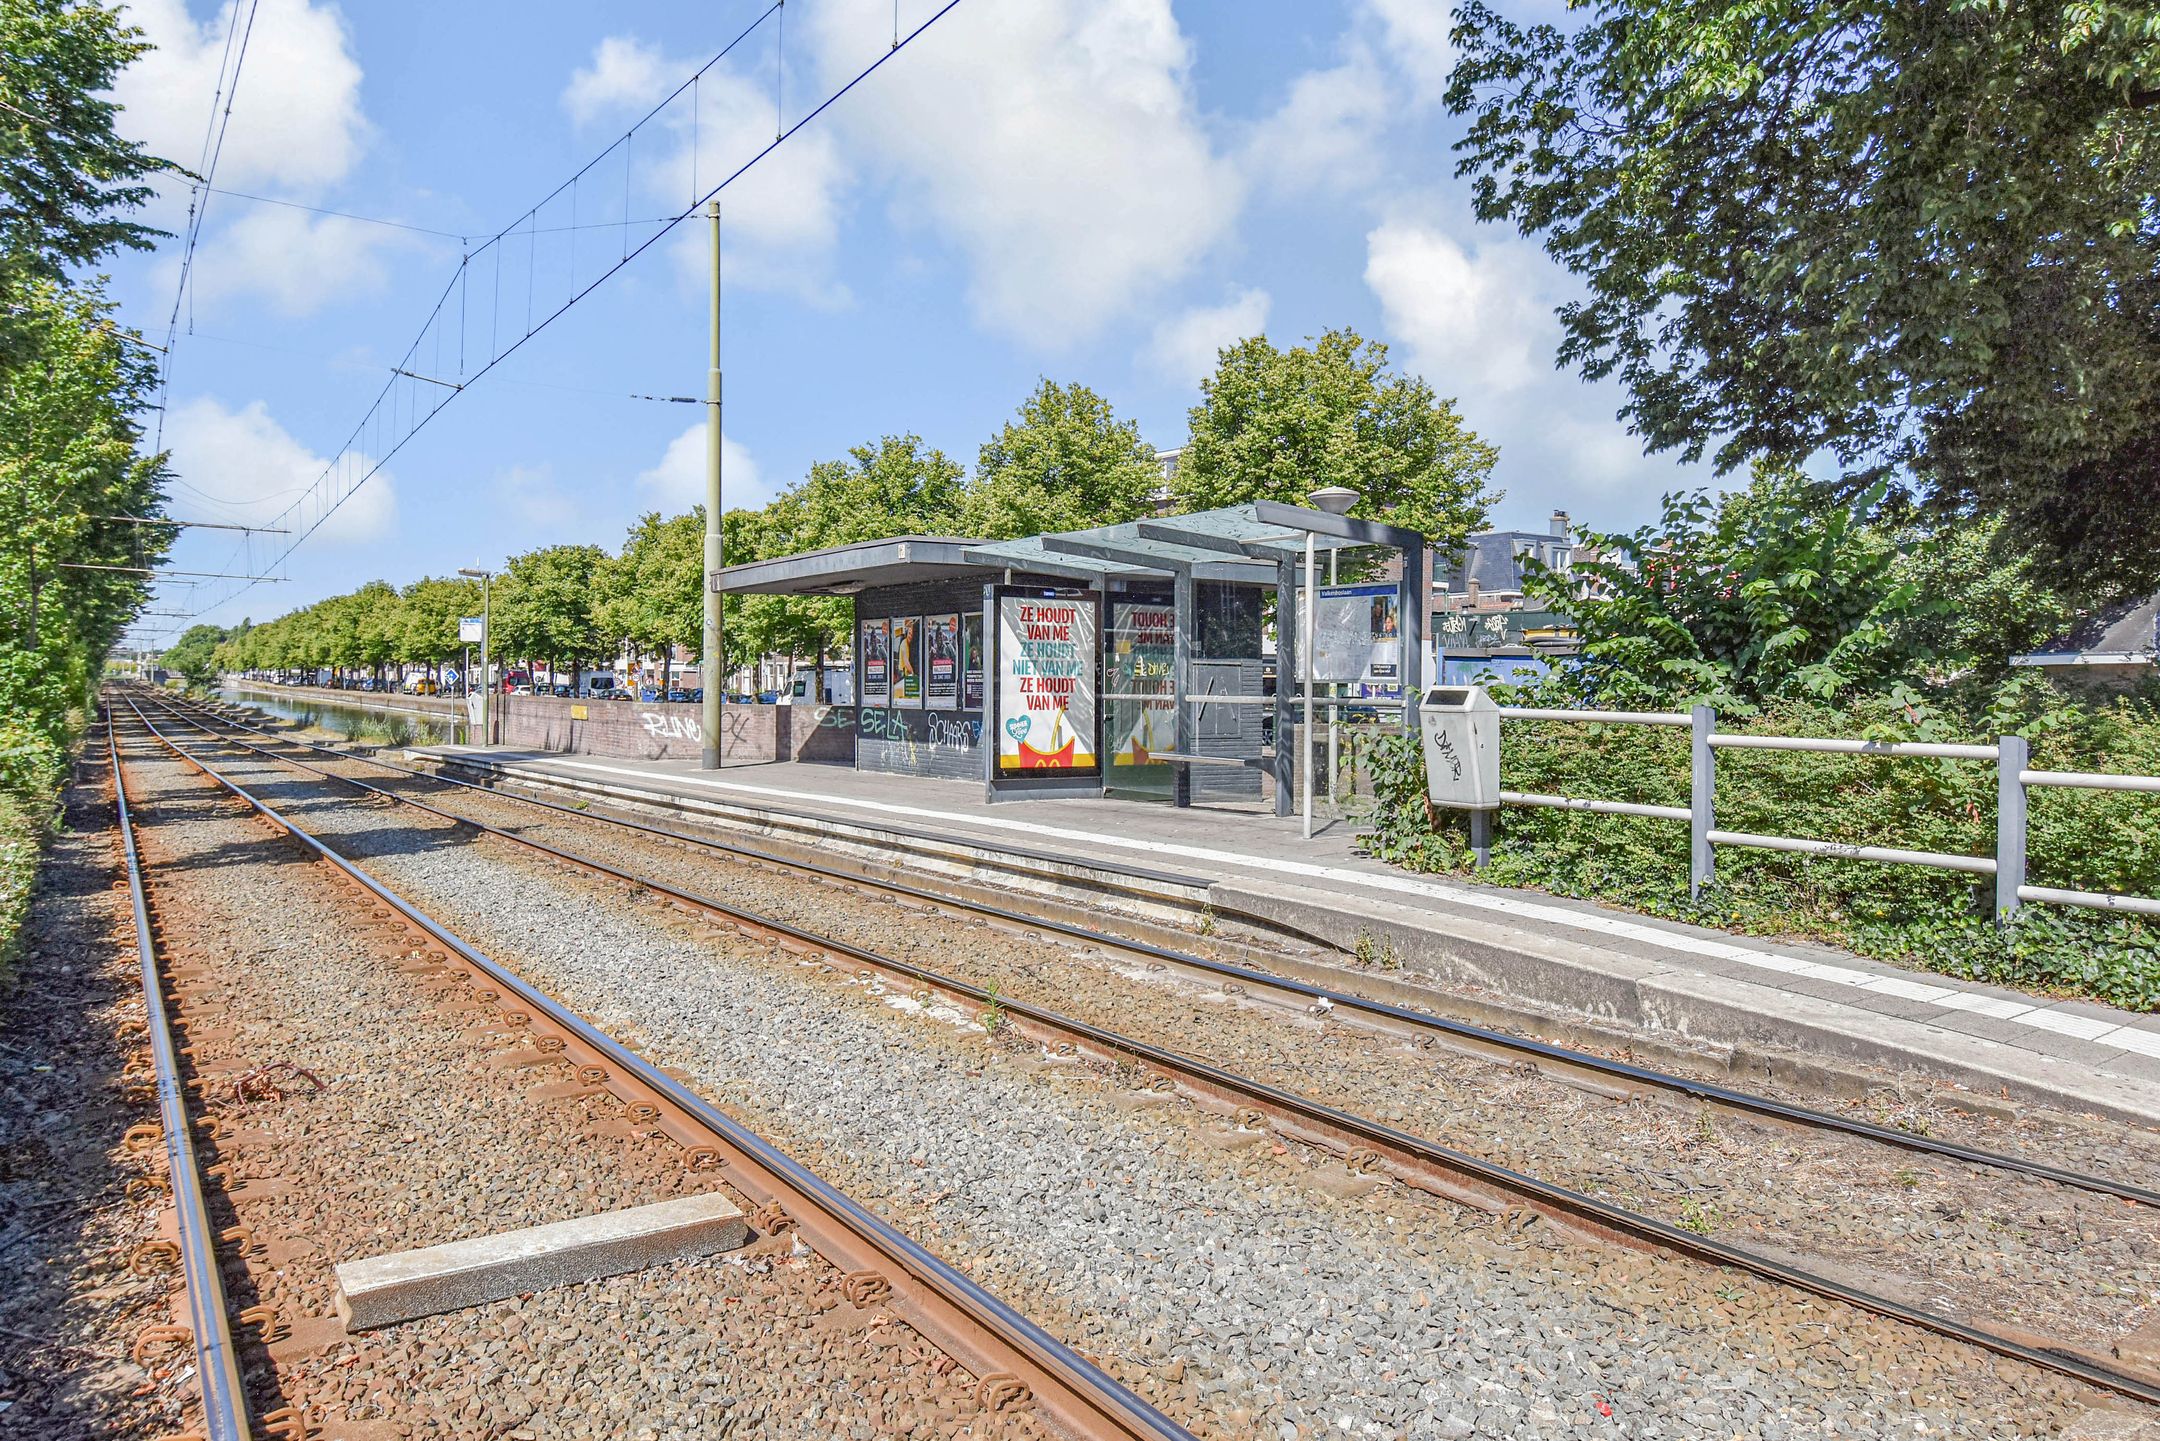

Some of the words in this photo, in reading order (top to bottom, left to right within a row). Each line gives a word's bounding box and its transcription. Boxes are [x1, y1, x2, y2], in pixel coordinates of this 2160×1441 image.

[1020, 606, 1034, 622] ZE
[1036, 607, 1076, 624] HOUDT
[1026, 624, 1050, 641] VAN
[1052, 625, 1070, 641] ME
[1020, 641, 1034, 658] ZE
[1036, 641, 1076, 659] HOUDT
[1012, 659, 1038, 676] NIET
[1040, 659, 1063, 676] VAN
[1066, 660, 1083, 677] ME
[1019, 677, 1034, 693] ZE
[1036, 677, 1076, 694] HOUDT
[1026, 695, 1050, 711] VAN
[1052, 695, 1070, 711] ME
